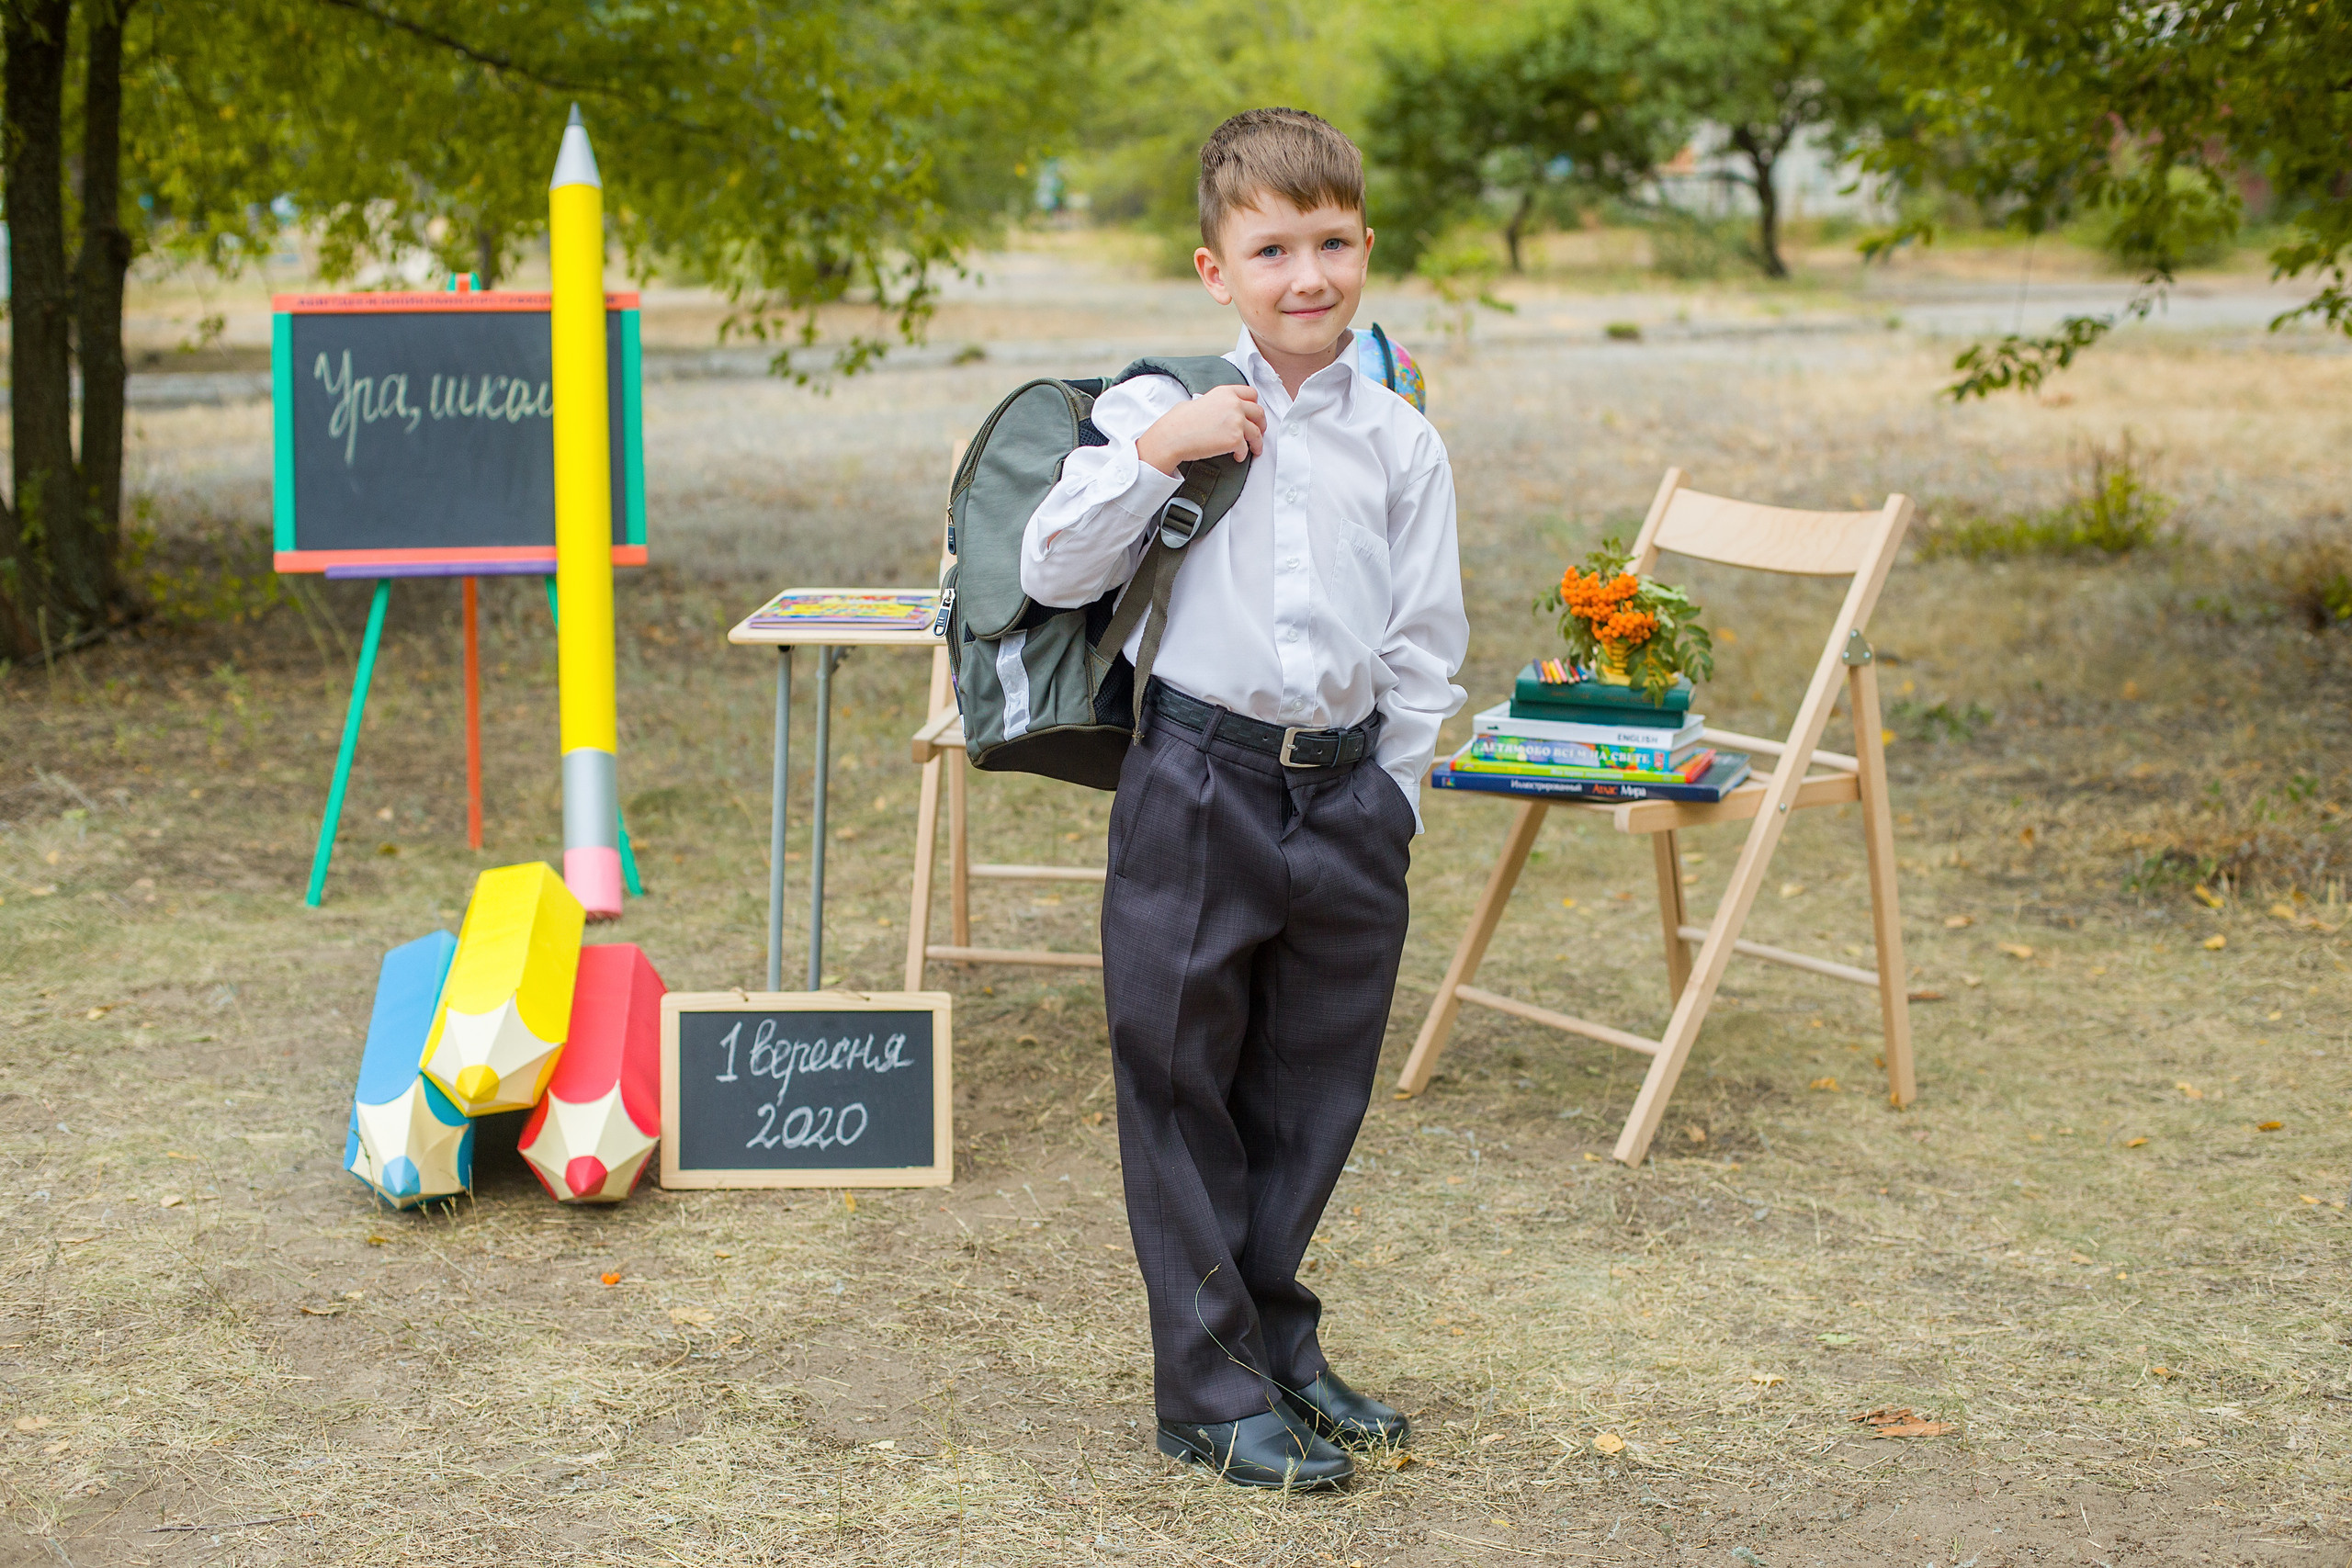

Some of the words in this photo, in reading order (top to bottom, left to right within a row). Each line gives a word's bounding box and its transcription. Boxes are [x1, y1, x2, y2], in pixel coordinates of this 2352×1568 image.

[429, 372, 555, 423] школ
[1617, 733, 1658, 744] ENGLISH
[1620, 784, 1647, 799] Мира
[716, 1021, 742, 1083] 1
[749, 1018, 914, 1107] вересня
[745, 1102, 868, 1152] 2020
